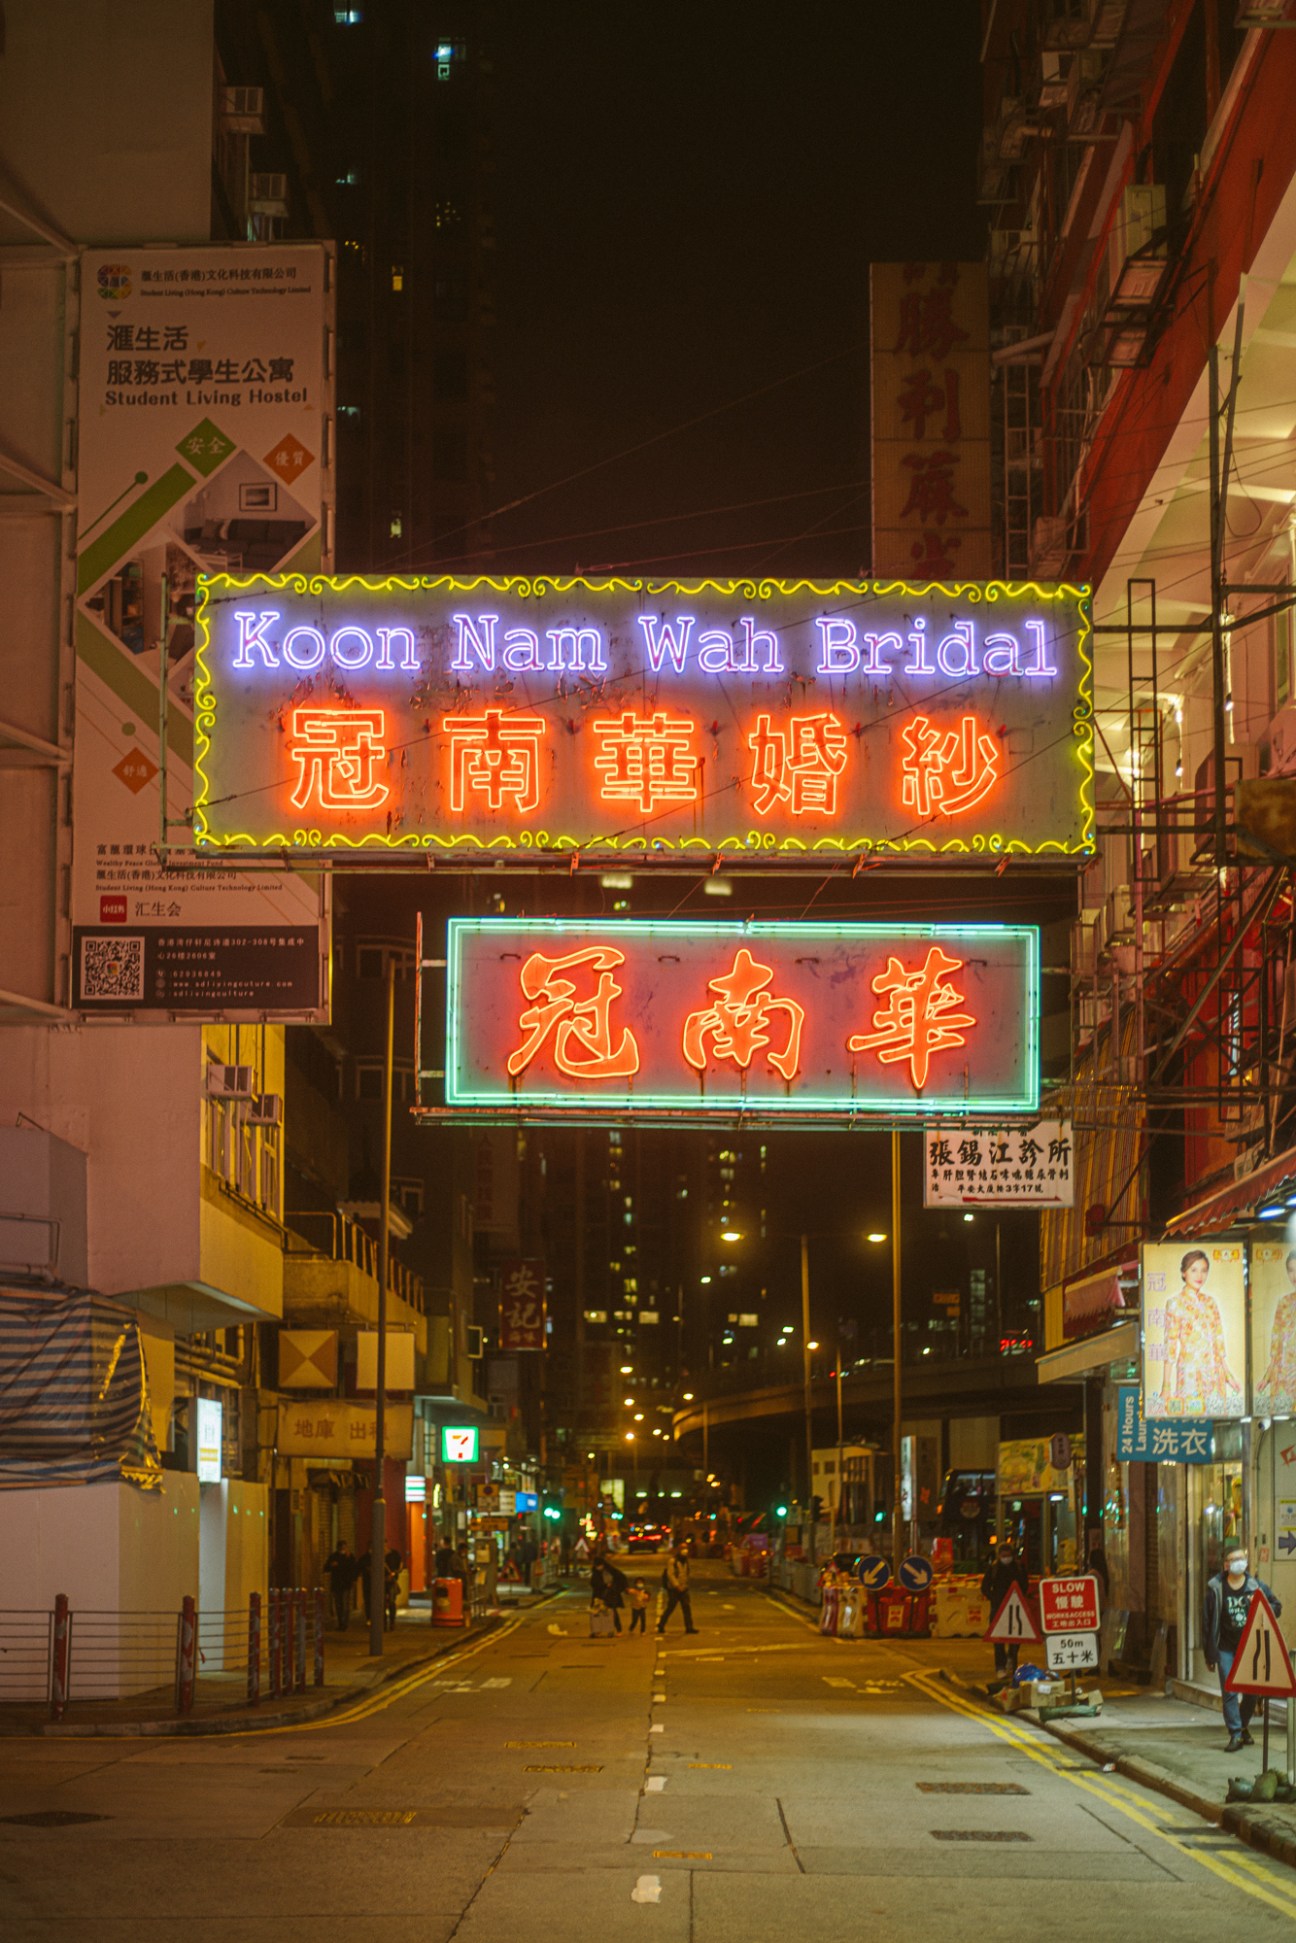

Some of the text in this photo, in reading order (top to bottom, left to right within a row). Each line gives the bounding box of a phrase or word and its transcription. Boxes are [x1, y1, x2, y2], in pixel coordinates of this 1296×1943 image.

[107, 357, 294, 385] 服務式學生公寓
[105, 388, 307, 406] Student Living Hostel
[186, 436, 226, 455] 安全
[233, 610, 1058, 677] Koon Nam Wah Bridal
[290, 708, 1000, 816] 冠南華婚紗
[123, 884, 142, 892] Living
[145, 884, 164, 892] (Hong
[166, 884, 188, 892] Kong)
[217, 884, 255, 892] Technology
[257, 883, 282, 891] Limited
[135, 901, 182, 917] 汇生会
[506, 945, 977, 1089] 冠南華
[929, 1138, 1072, 1168] 張錫江診所
[505, 1264, 541, 1329] 安記
[294, 1418, 335, 1440] 地庫
[1121, 1395, 1135, 1454] 24 Hours
[1152, 1426, 1208, 1456] 洗衣
[1052, 1582, 1085, 1594] SLOW
[1060, 1638, 1084, 1649] 50m
[1052, 1649, 1094, 1665] 五十米
